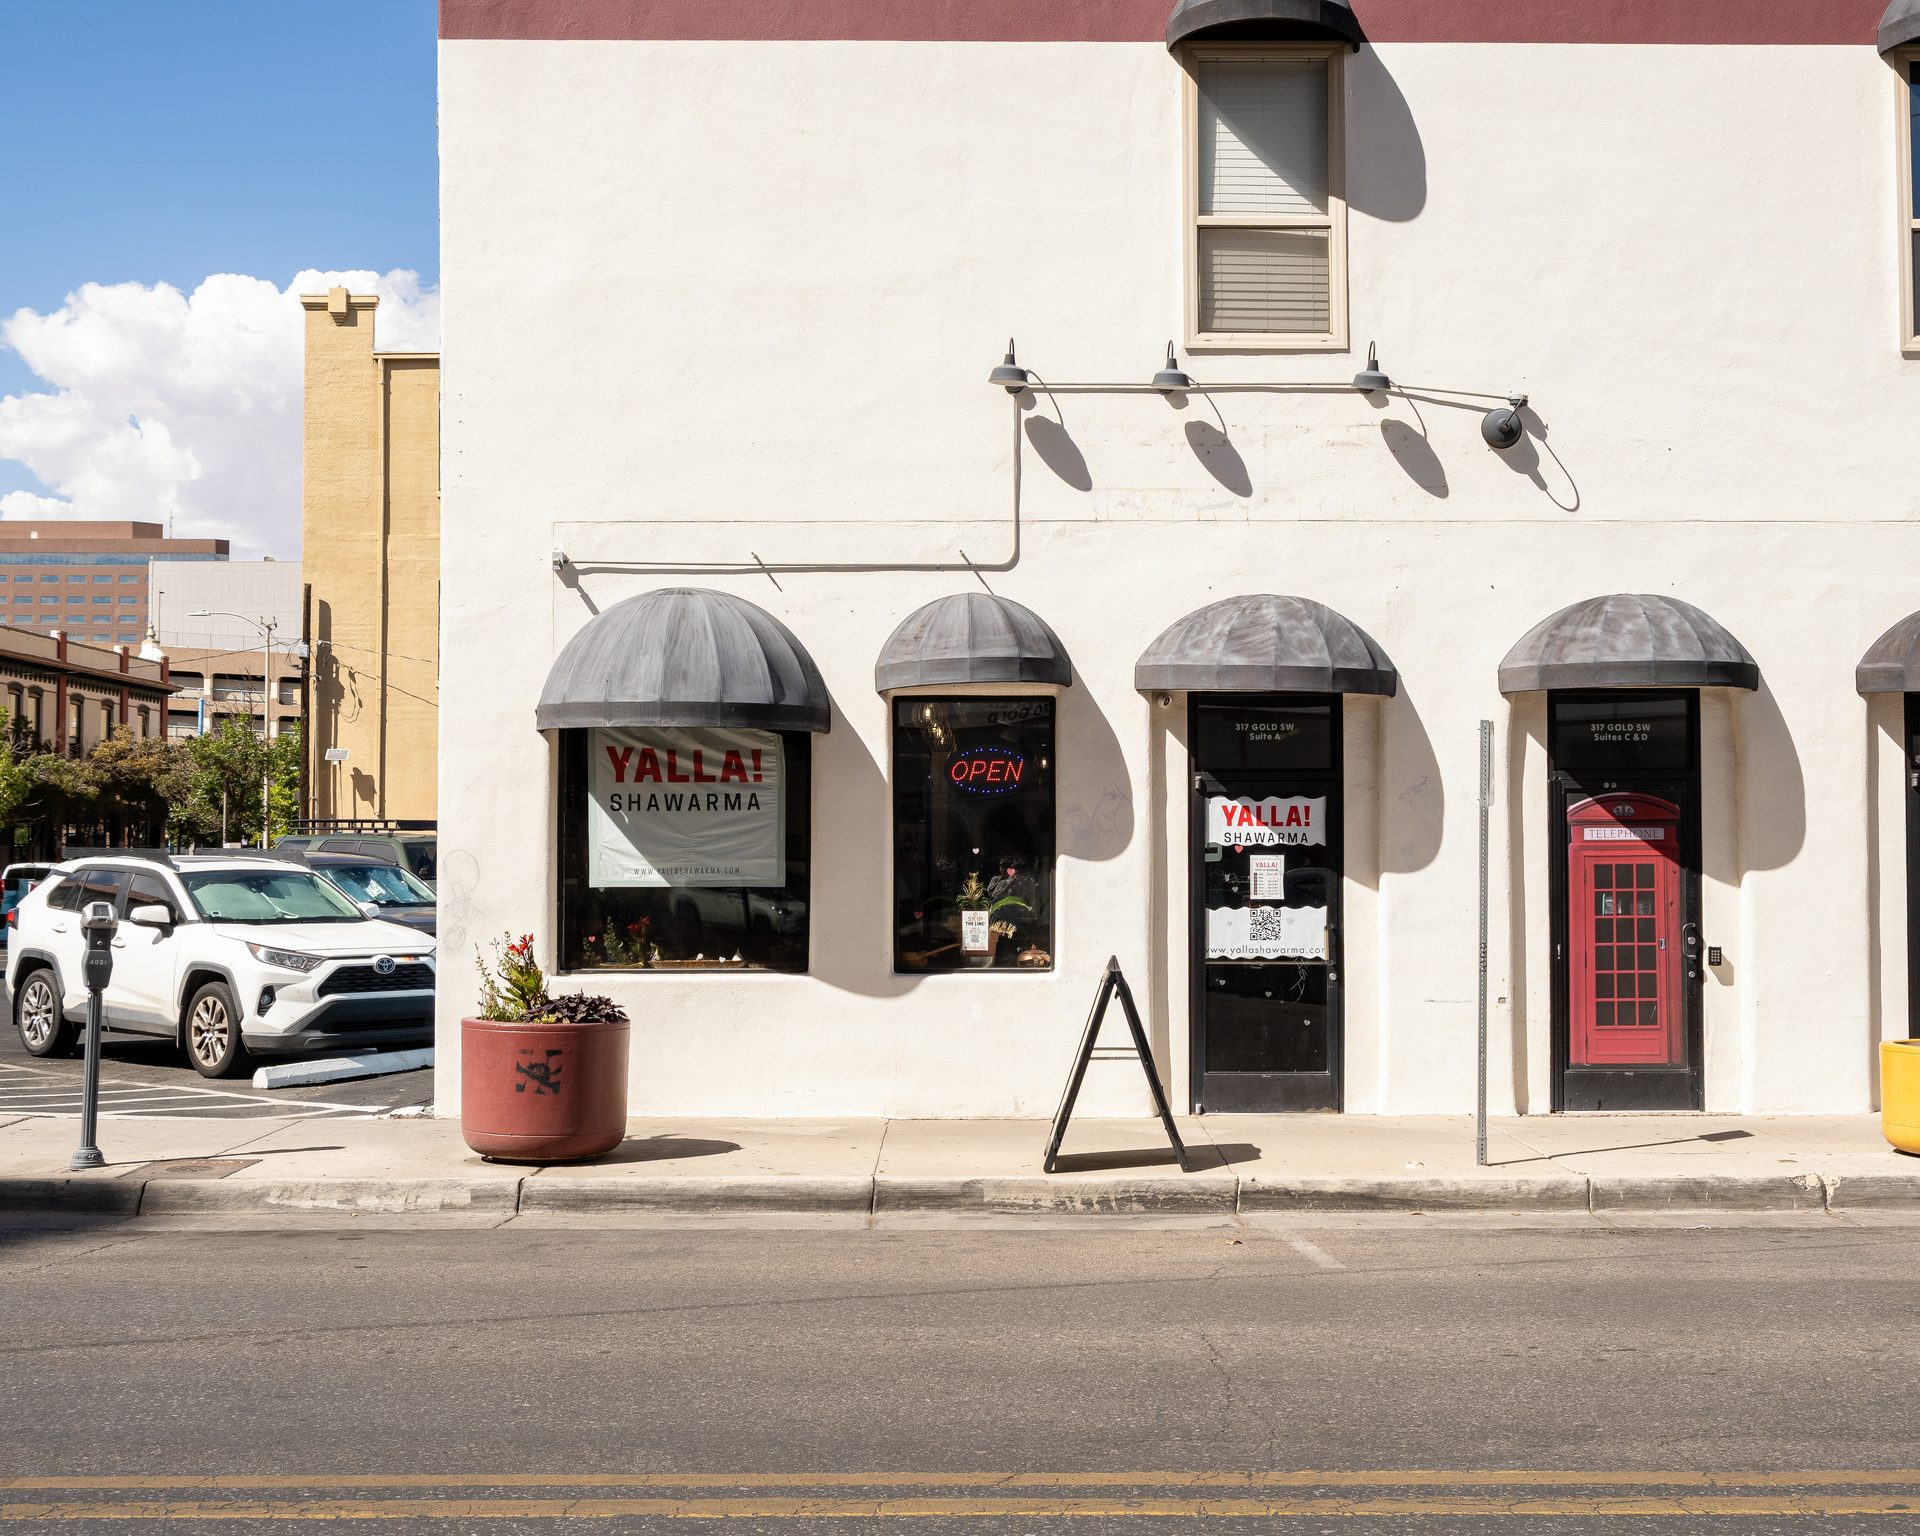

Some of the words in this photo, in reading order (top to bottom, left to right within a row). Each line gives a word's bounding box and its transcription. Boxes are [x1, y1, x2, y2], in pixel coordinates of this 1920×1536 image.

[1235, 723, 1249, 731] 317
[1251, 723, 1278, 731] GOLD
[1280, 723, 1295, 731] SW
[1590, 723, 1605, 732] 317
[1607, 723, 1634, 732] GOLD
[1636, 723, 1651, 732] SW
[1249, 732, 1273, 741] Suite
[1274, 732, 1281, 741] A
[1593, 733, 1622, 741] Suites
[1624, 733, 1631, 741] C
[1633, 733, 1640, 741] &
[1641, 733, 1648, 741] D
[606, 746, 763, 783] YALLA!
[951, 760, 1024, 782] OPEN
[610, 793, 761, 812] SHAWARMA
[1221, 805, 1311, 827] YALLA!
[1223, 832, 1309, 844] SHAWARMA
[1588, 829, 1660, 839] TELEPHONE
